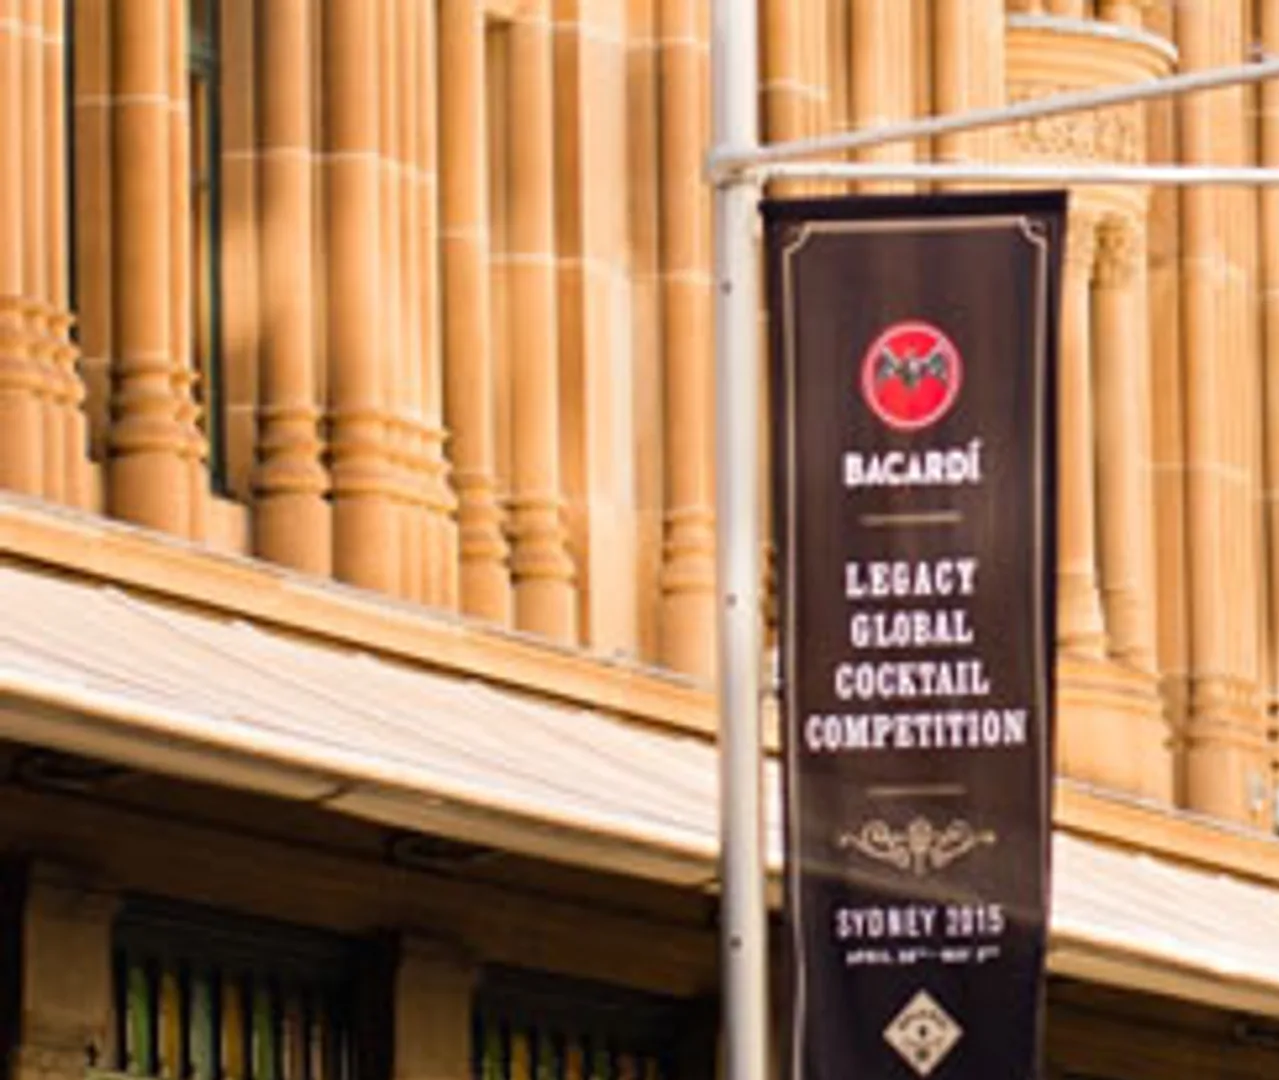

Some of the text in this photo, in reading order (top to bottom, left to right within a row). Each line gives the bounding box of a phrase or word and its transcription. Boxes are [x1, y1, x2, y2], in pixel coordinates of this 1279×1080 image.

[842, 439, 982, 487] BACARDÍ
[846, 559, 976, 598] LEGACY
[851, 608, 973, 649] GLOBAL
[834, 661, 990, 698] COCKTAIL
[805, 709, 1027, 751] COMPETITION
[836, 903, 1005, 940] SYDNEY 2015
